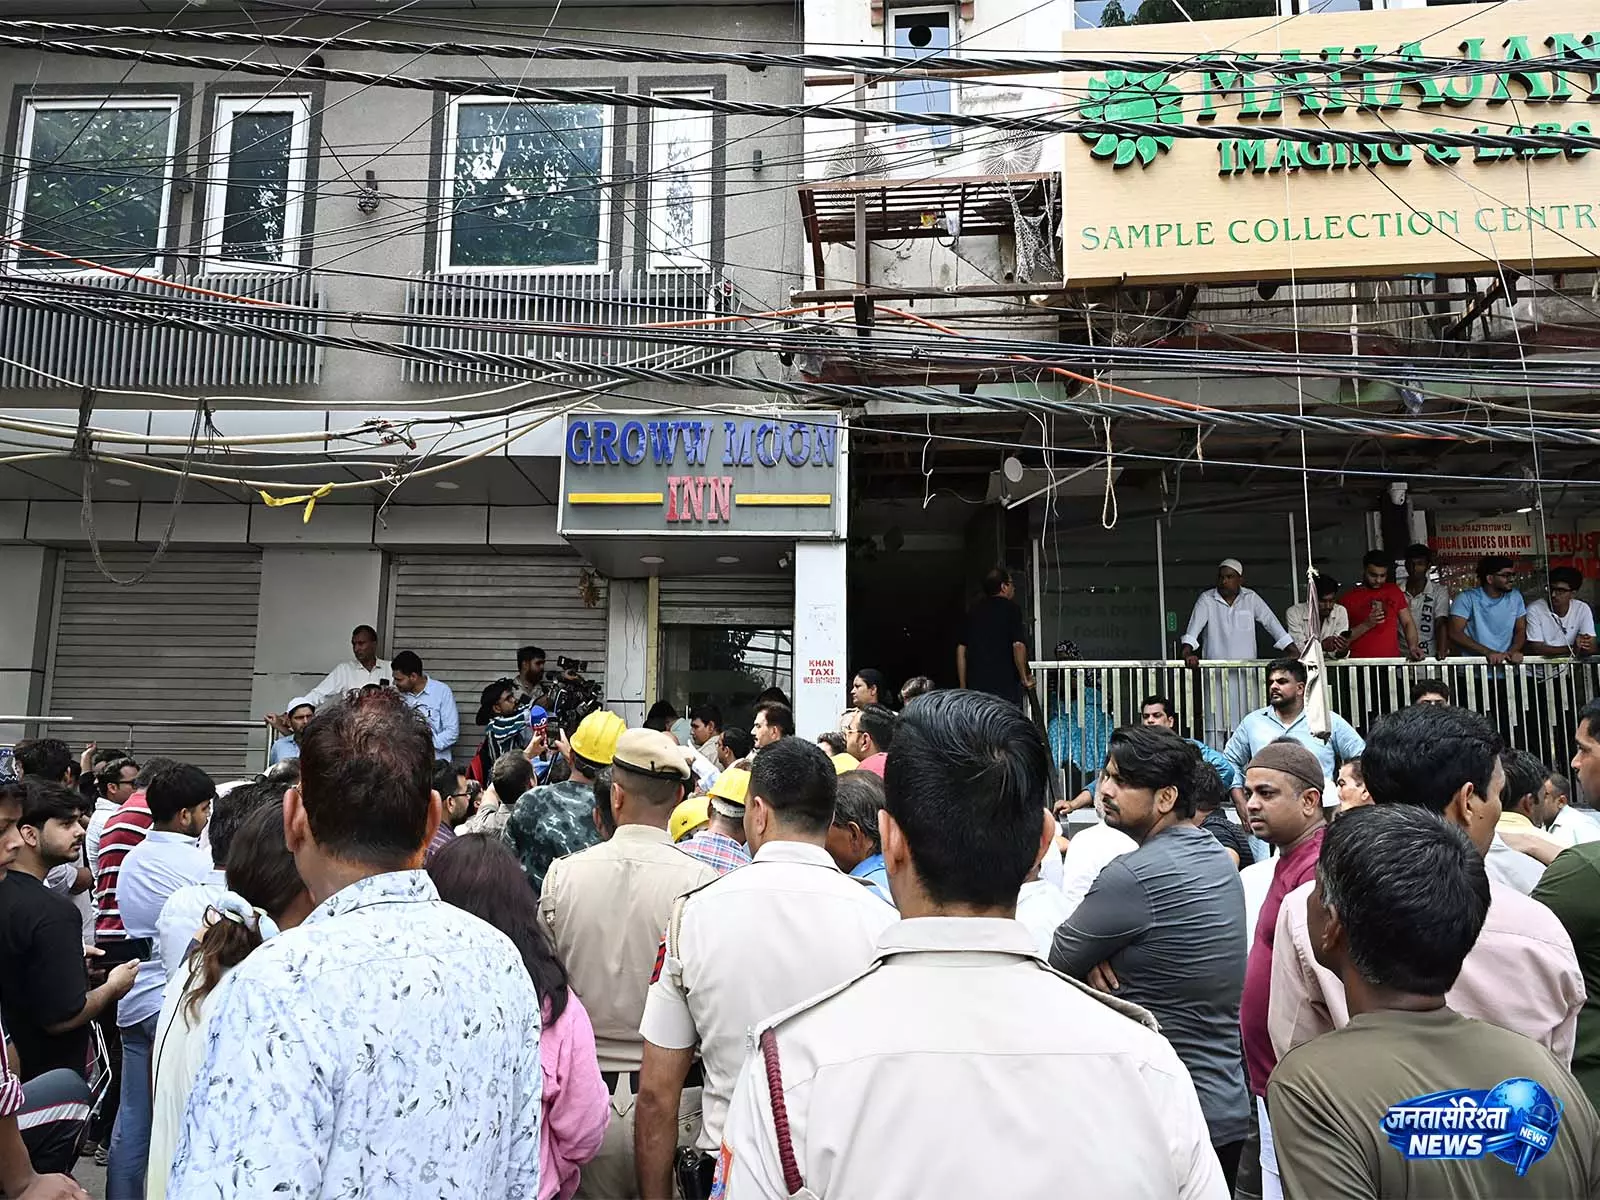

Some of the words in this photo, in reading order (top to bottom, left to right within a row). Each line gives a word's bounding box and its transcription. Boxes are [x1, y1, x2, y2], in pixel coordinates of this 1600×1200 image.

[1217, 132, 1412, 176] IMAGING
[1081, 221, 1216, 251] SAMPLE
[1228, 208, 1460, 245] COLLECTION
[1474, 203, 1600, 232] CENTR
[566, 420, 713, 466] GROWW
[722, 420, 838, 467] MOON
[665, 475, 733, 523] INN
[1462, 536, 1497, 549] DEVICES
[1498, 535, 1509, 549] ON
[1510, 535, 1532, 548] RENT
[1420, 593, 1434, 633] AERO
[808, 659, 834, 667] KHAN
[808, 668, 834, 676] TAXI
